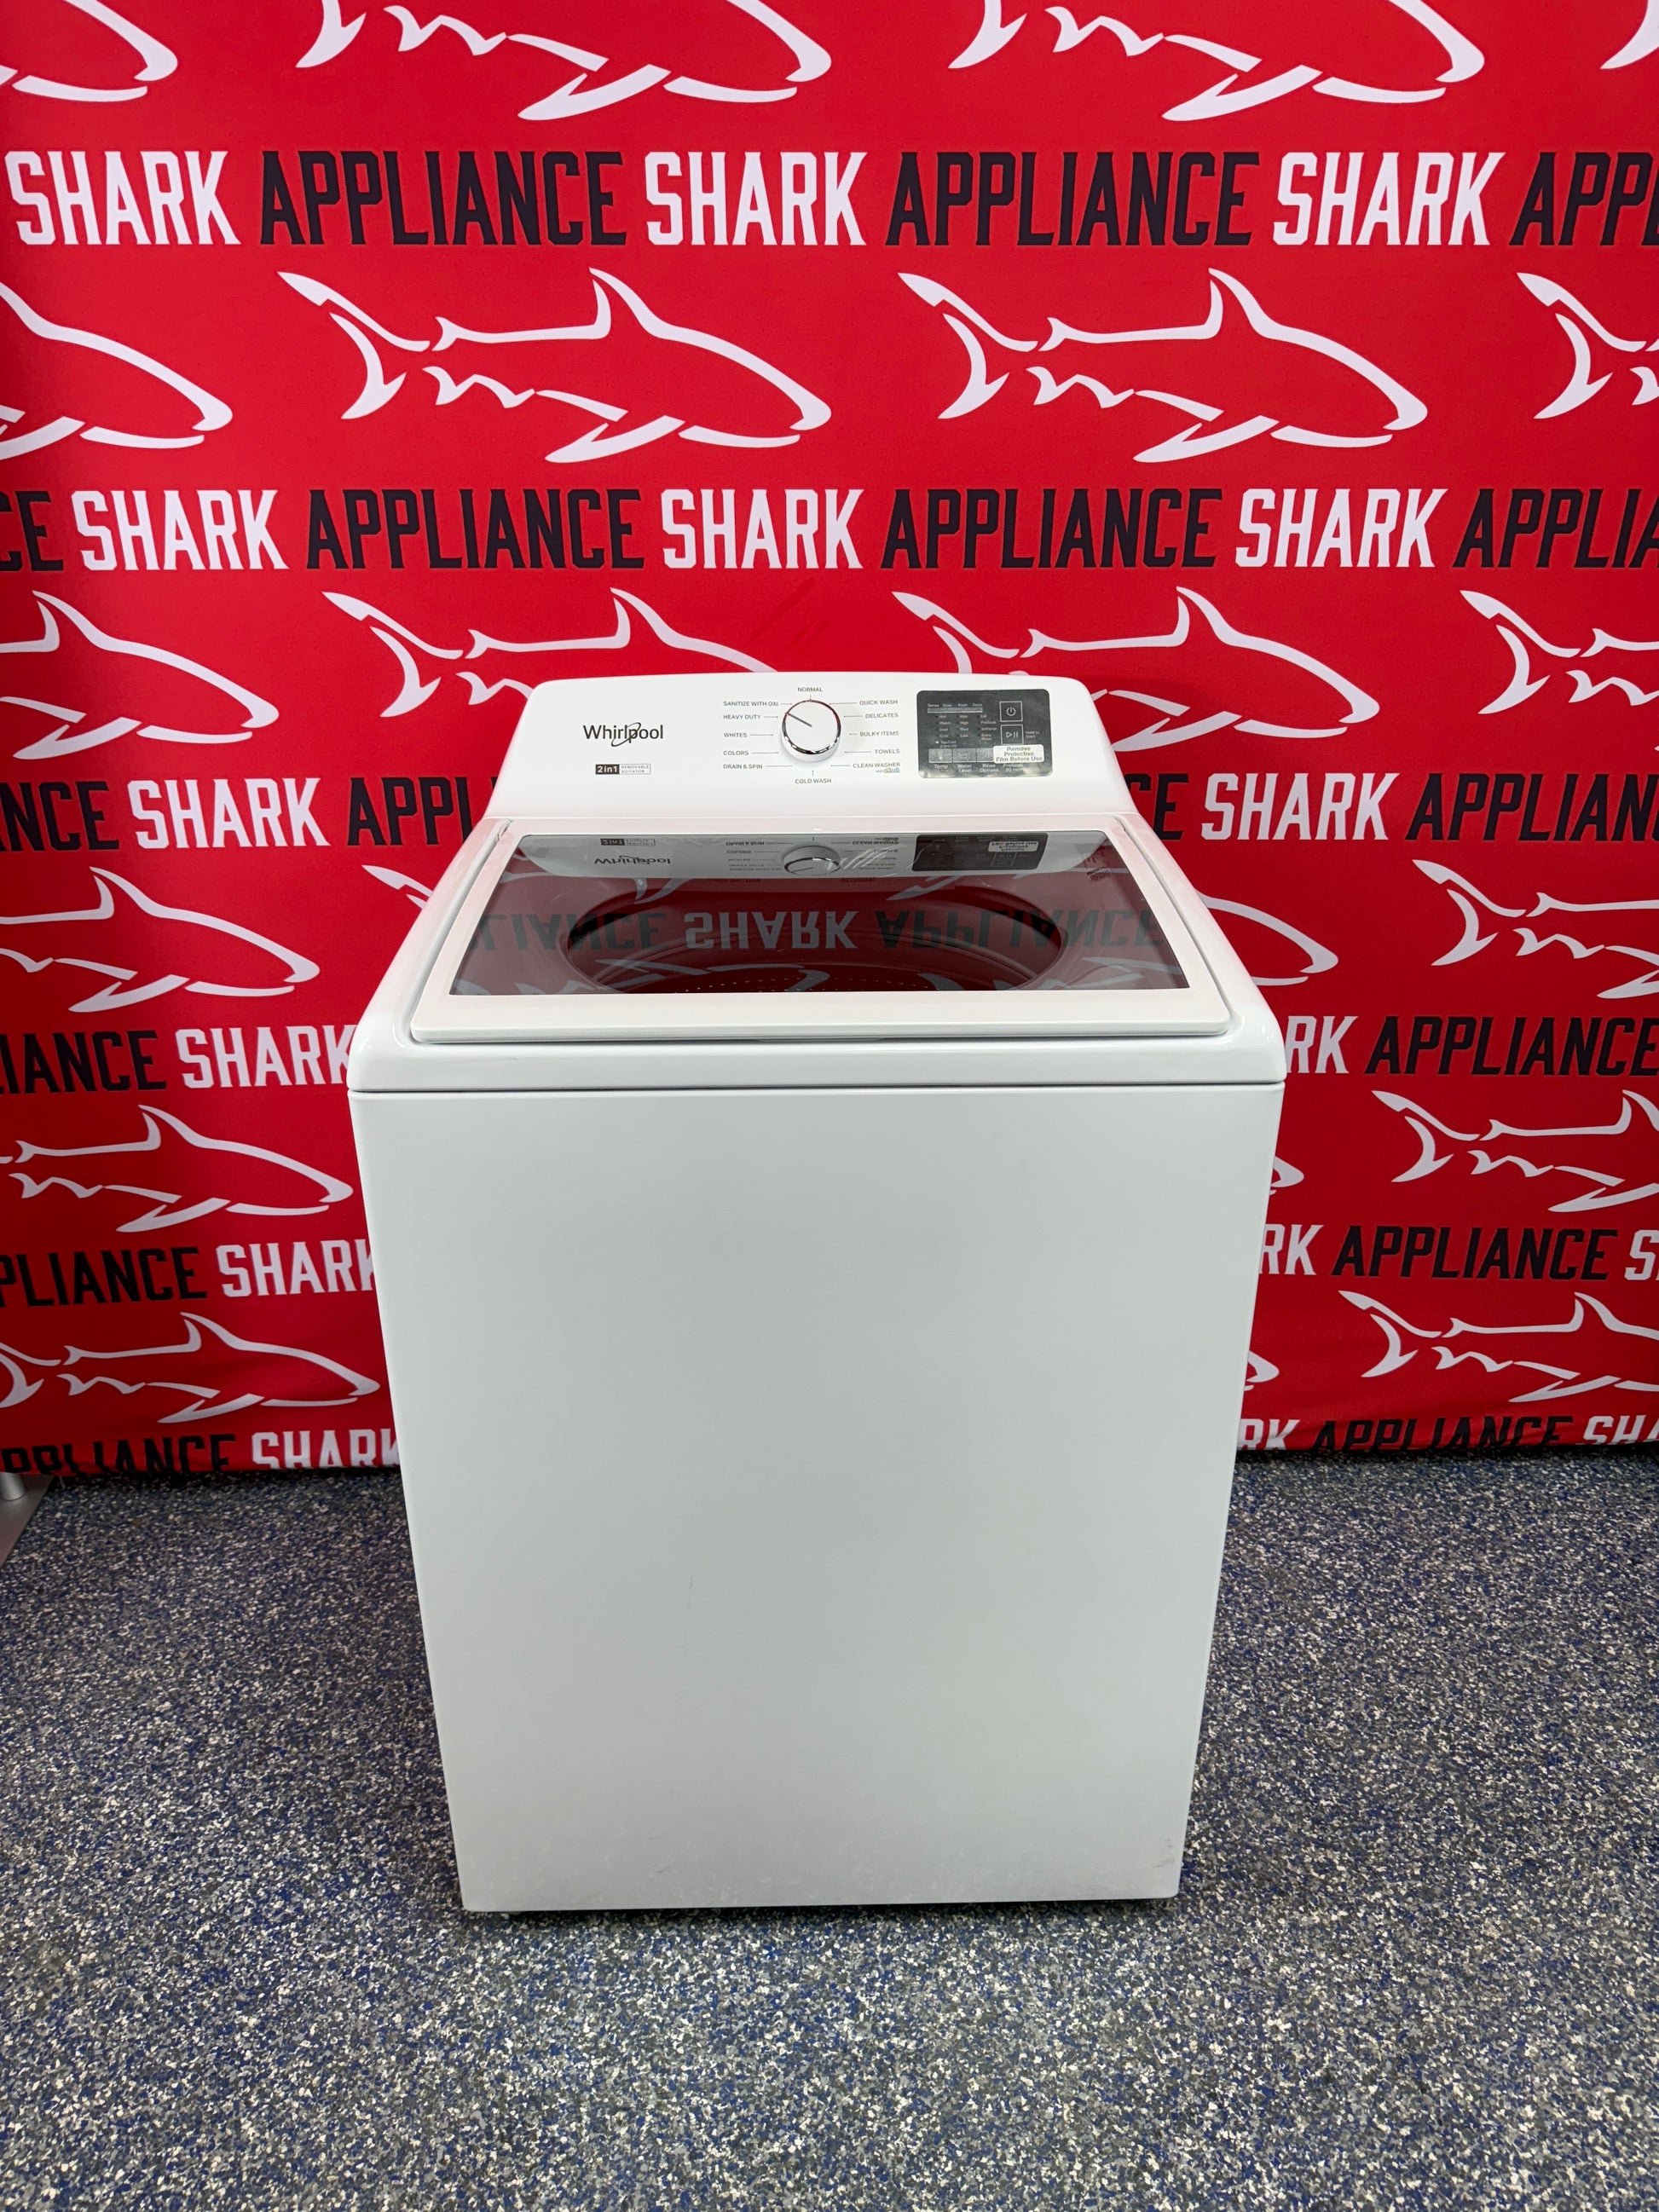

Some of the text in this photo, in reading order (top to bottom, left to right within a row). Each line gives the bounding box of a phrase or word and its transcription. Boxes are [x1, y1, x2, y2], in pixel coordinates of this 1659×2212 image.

[5, 152, 1659, 245] SHARK APPLIANCE SHARK APPLIANCE SHARK APP
[72, 490, 288, 570] SHARK
[308, 490, 643, 569] APPLIANCE
[662, 489, 863, 569] SHARK
[882, 489, 1222, 568] APPLIANCE
[1235, 489, 1447, 567] SHARK
[582, 721, 663, 747] Whirlpool
[0, 777, 496, 852] NCE SHARK APPL
[1202, 773, 1399, 840] SHARK
[1406, 774, 1659, 840] APPLIAN
[1365, 1017, 1659, 1076] APPLIANCE
[1332, 1226, 1617, 1279] APPLIANCE
[1625, 1230, 1659, 1279] S
[1580, 1415, 1659, 1446] SH
